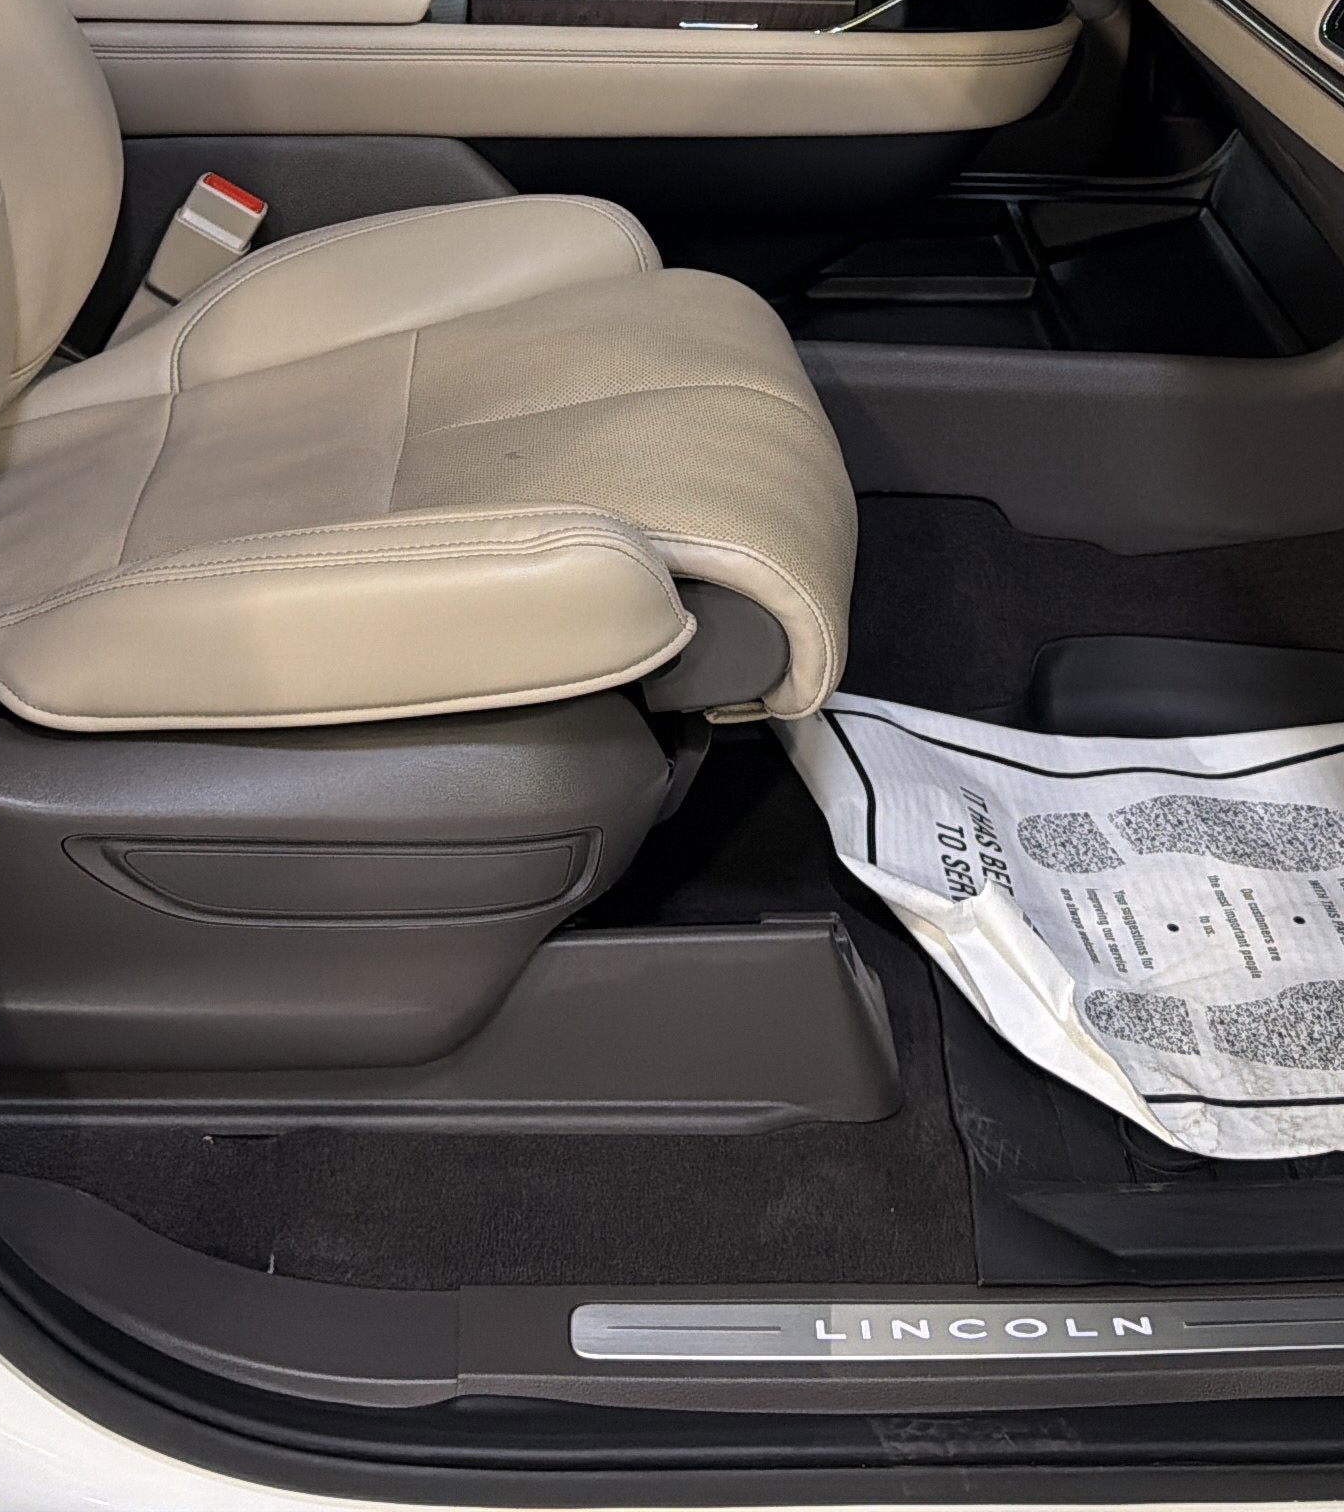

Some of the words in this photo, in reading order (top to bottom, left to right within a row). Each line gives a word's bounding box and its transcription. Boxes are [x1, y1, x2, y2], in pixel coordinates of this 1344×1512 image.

[960, 786, 989, 813] IT
[936, 821, 967, 852] TO
[967, 806, 1002, 853] HAS
[941, 854, 978, 902] SER
[1308, 880, 1329, 899] WITH
[1320, 900, 1341, 919] THIS
[1121, 907, 1148, 956] suggestions
[1224, 908, 1251, 947] important
[1238, 950, 1262, 978] people
[1248, 902, 1274, 944] customers
[814, 1316, 1154, 1341] LINCOLN
